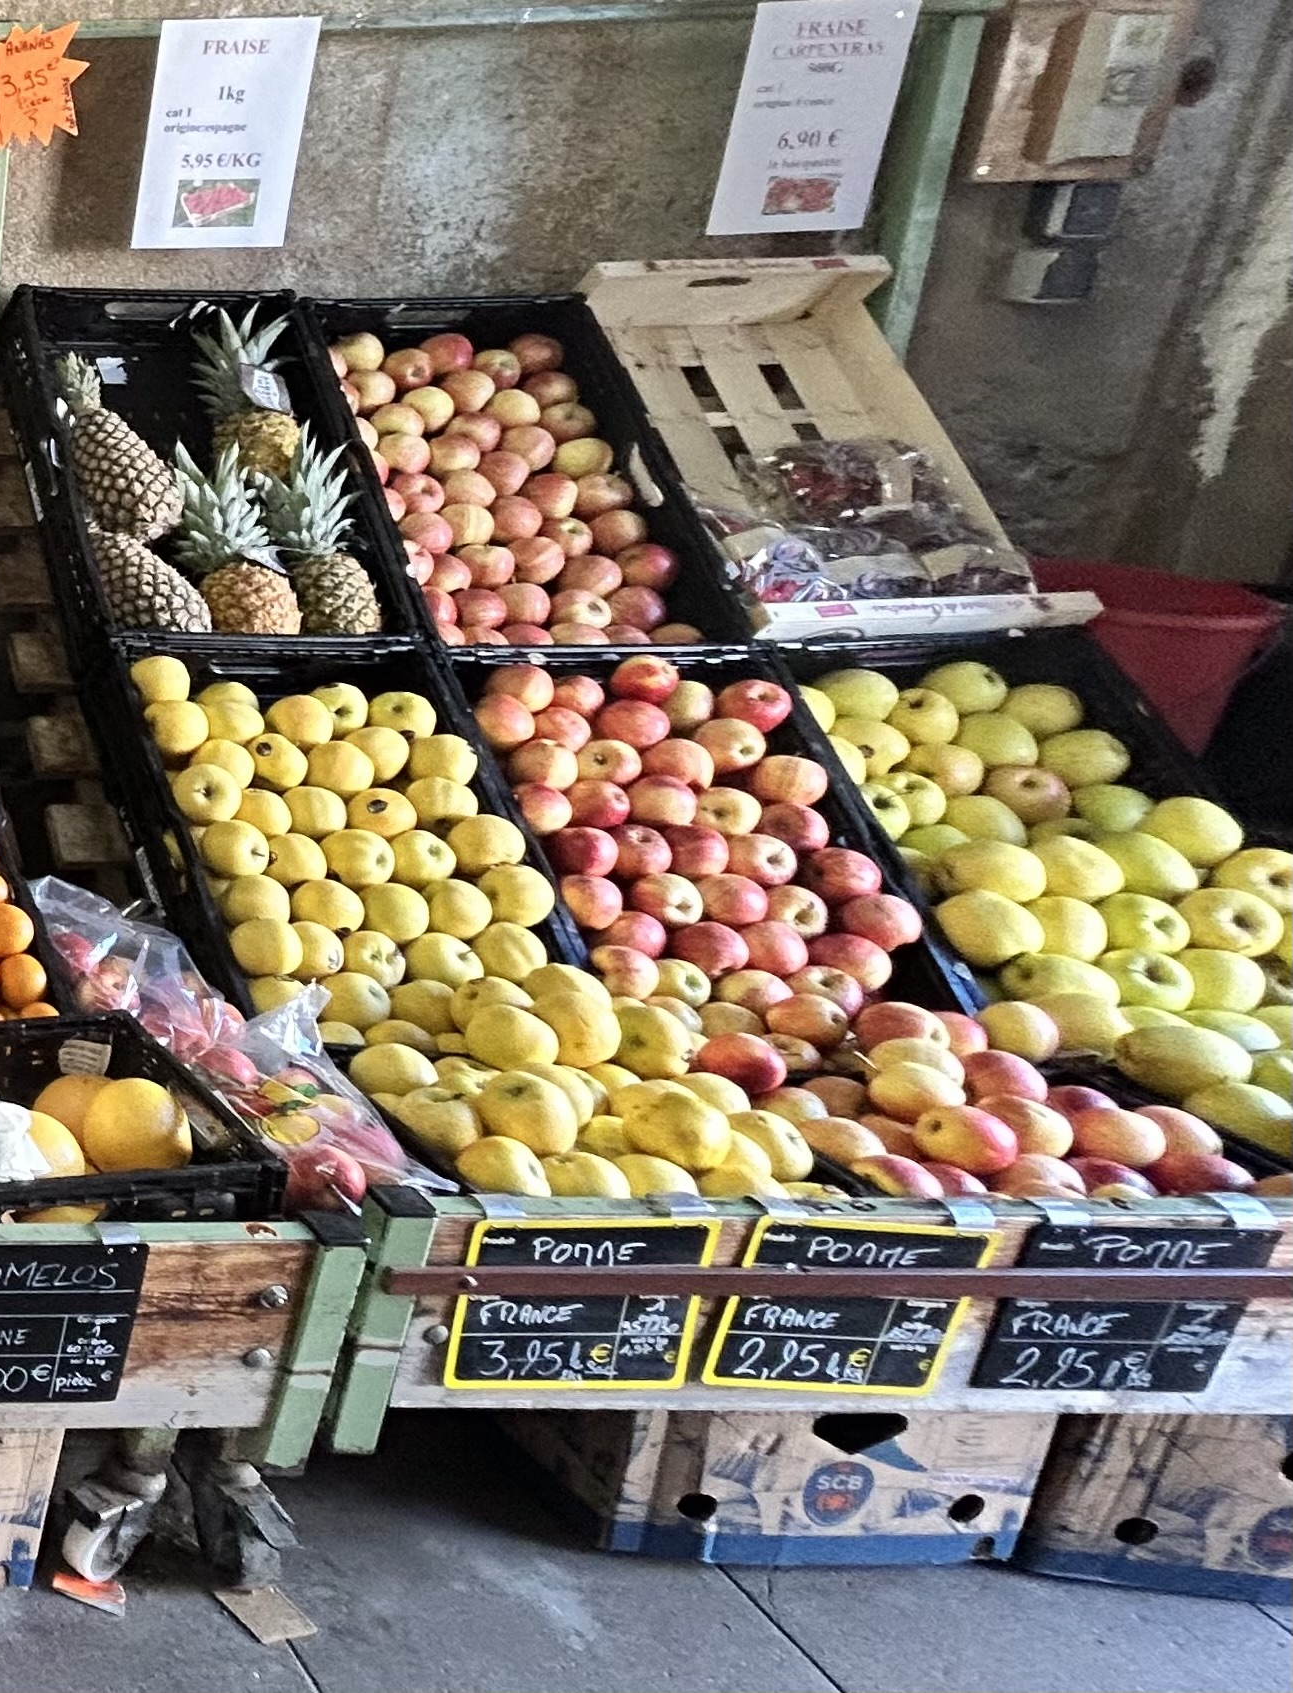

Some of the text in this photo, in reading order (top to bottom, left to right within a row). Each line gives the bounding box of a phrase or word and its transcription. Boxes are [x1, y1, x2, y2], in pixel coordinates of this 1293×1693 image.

[796, 19, 868, 36] FRAISE
[6, 37, 54, 57] ANANAS
[203, 39, 271, 55] FRAISE
[772, 41, 886, 57] CARPENTRAS
[166, 108, 184, 118] cat
[181, 153, 262, 169] 5,95 €/KG
[479, 1301, 584, 1326] FRANCE
[744, 1303, 841, 1330] FRANCE
[1012, 1310, 1130, 1336] FRANCE
[589, 1343, 613, 1364] €
[849, 1348, 872, 1368] €
[31, 1364, 52, 1382] €
[816, 1475, 863, 1490] SCB
